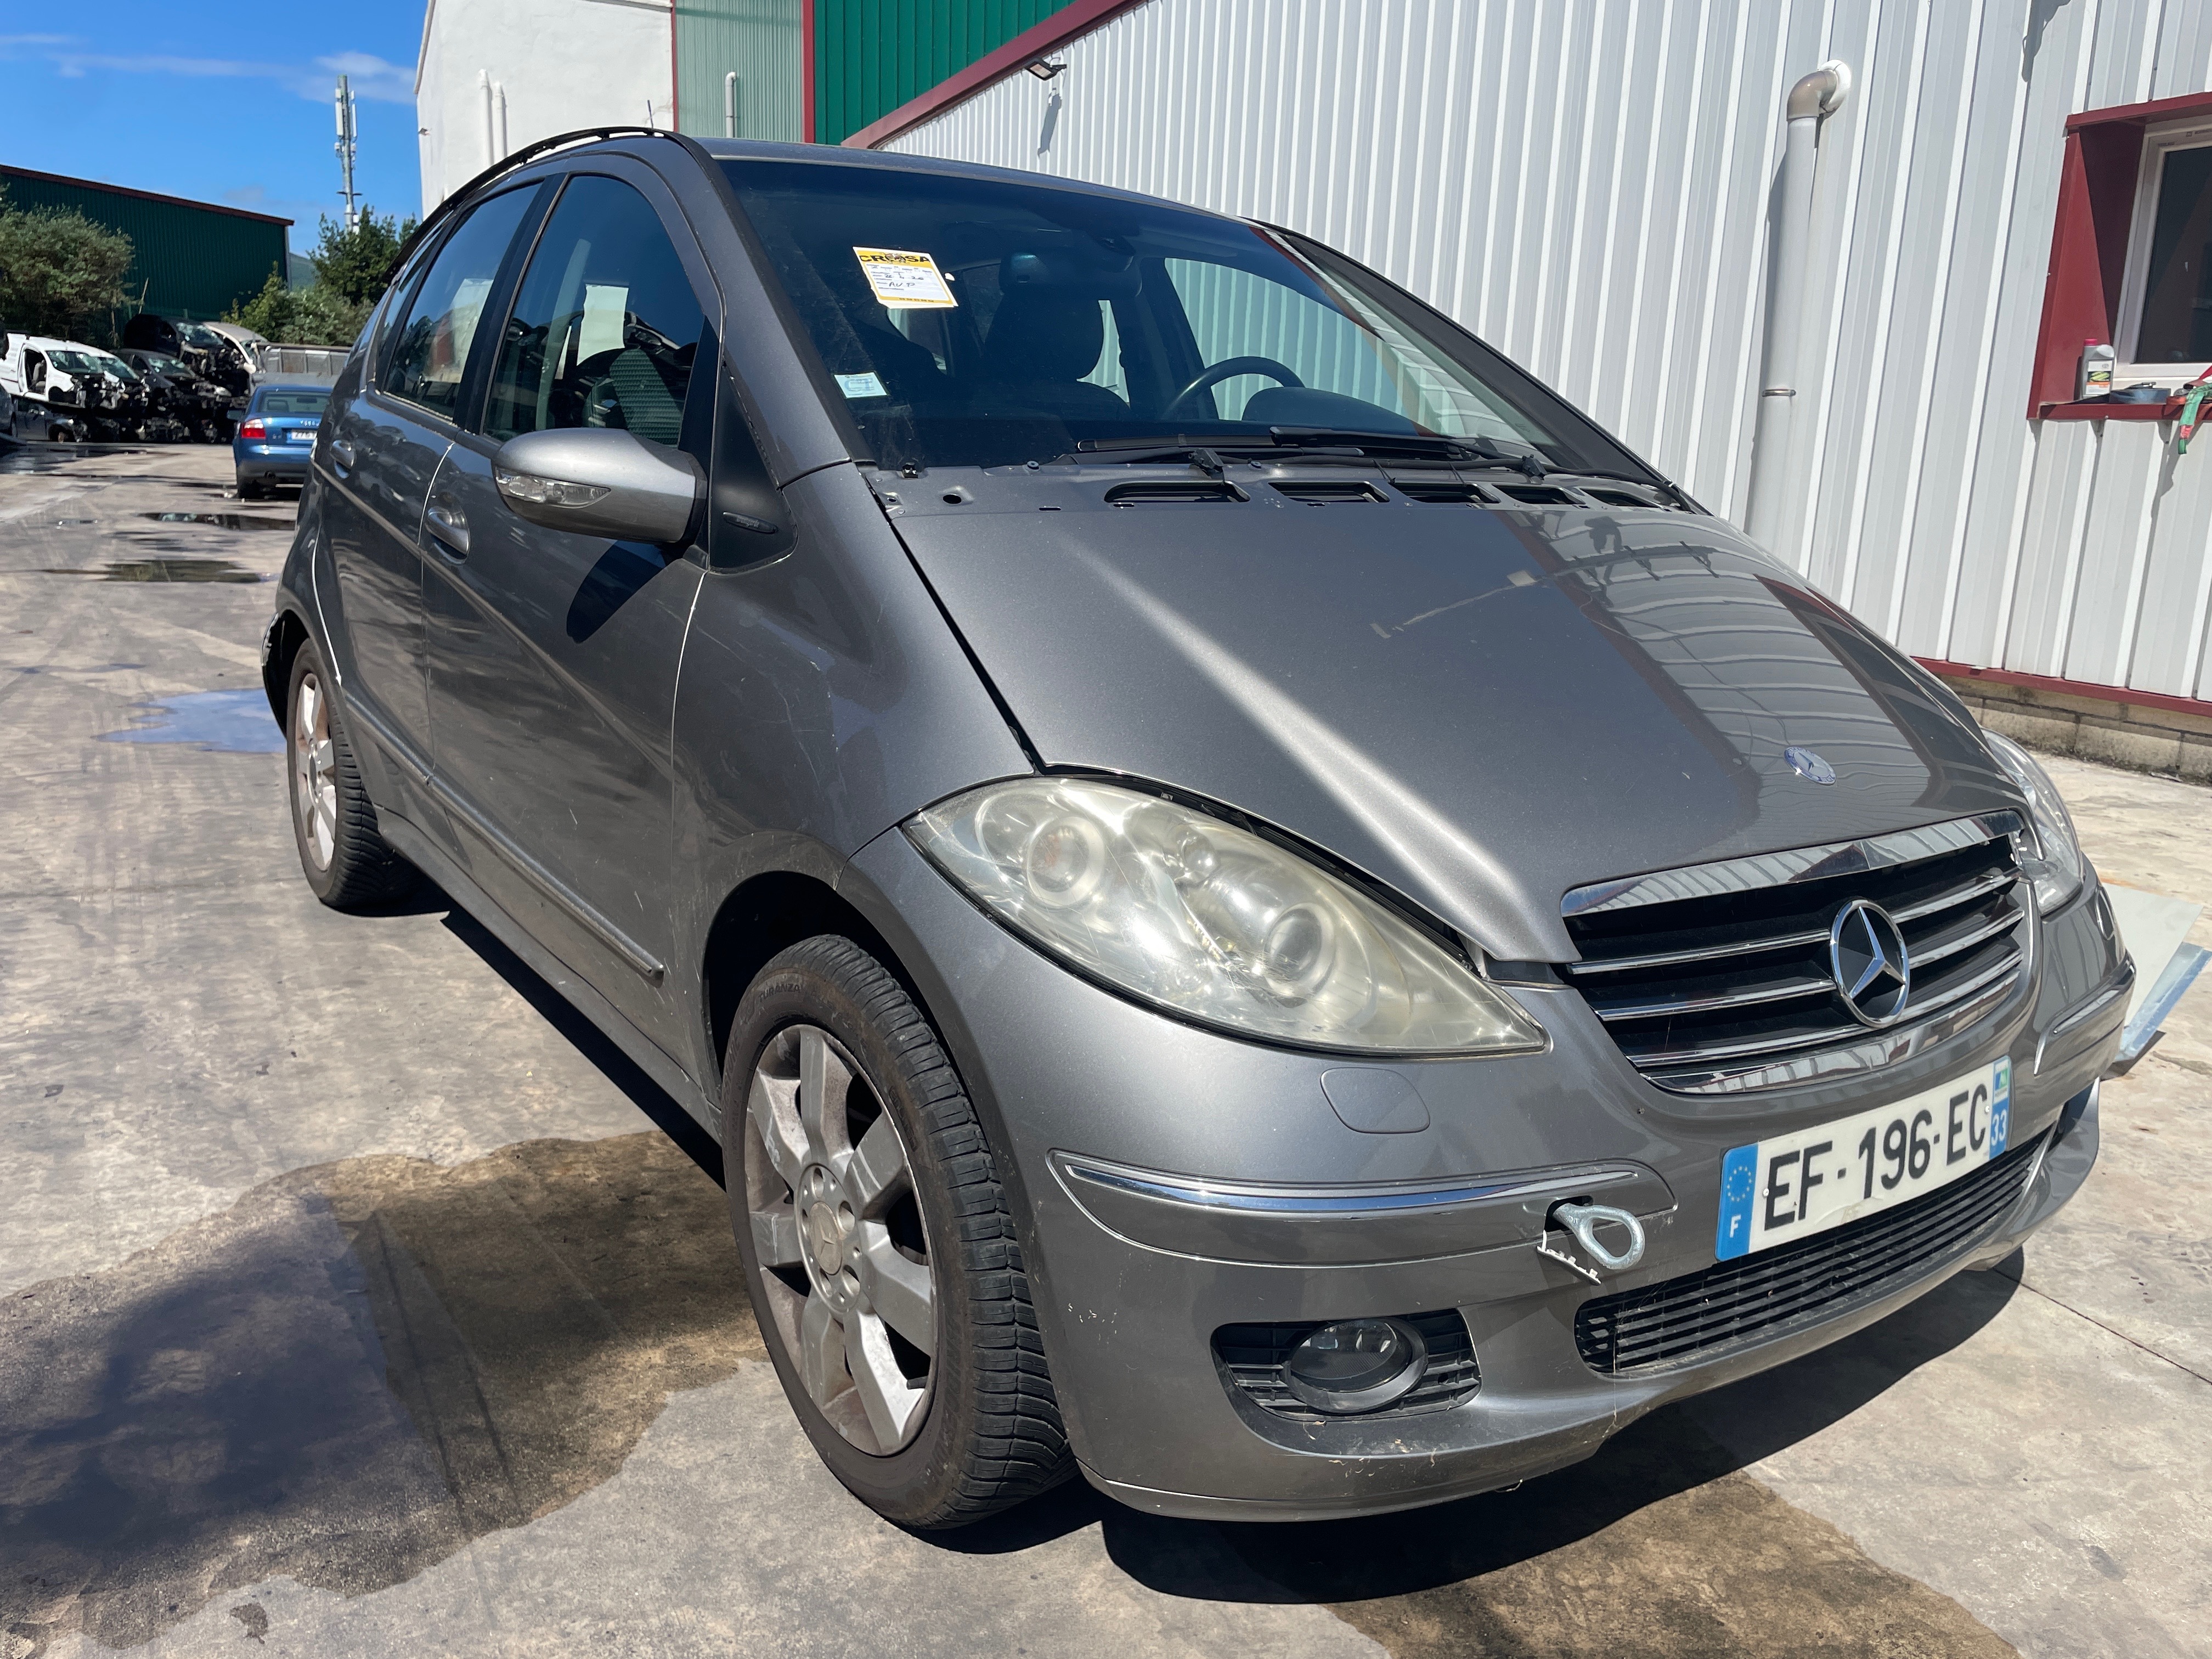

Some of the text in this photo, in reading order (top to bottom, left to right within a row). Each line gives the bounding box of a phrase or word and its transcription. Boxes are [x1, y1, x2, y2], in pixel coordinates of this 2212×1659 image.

[758, 983, 800, 1003] TURANZA
[1990, 1109, 2007, 1147] 33
[1764, 1084, 1987, 1231] EF-196-EC
[1730, 1214, 1742, 1238] F
